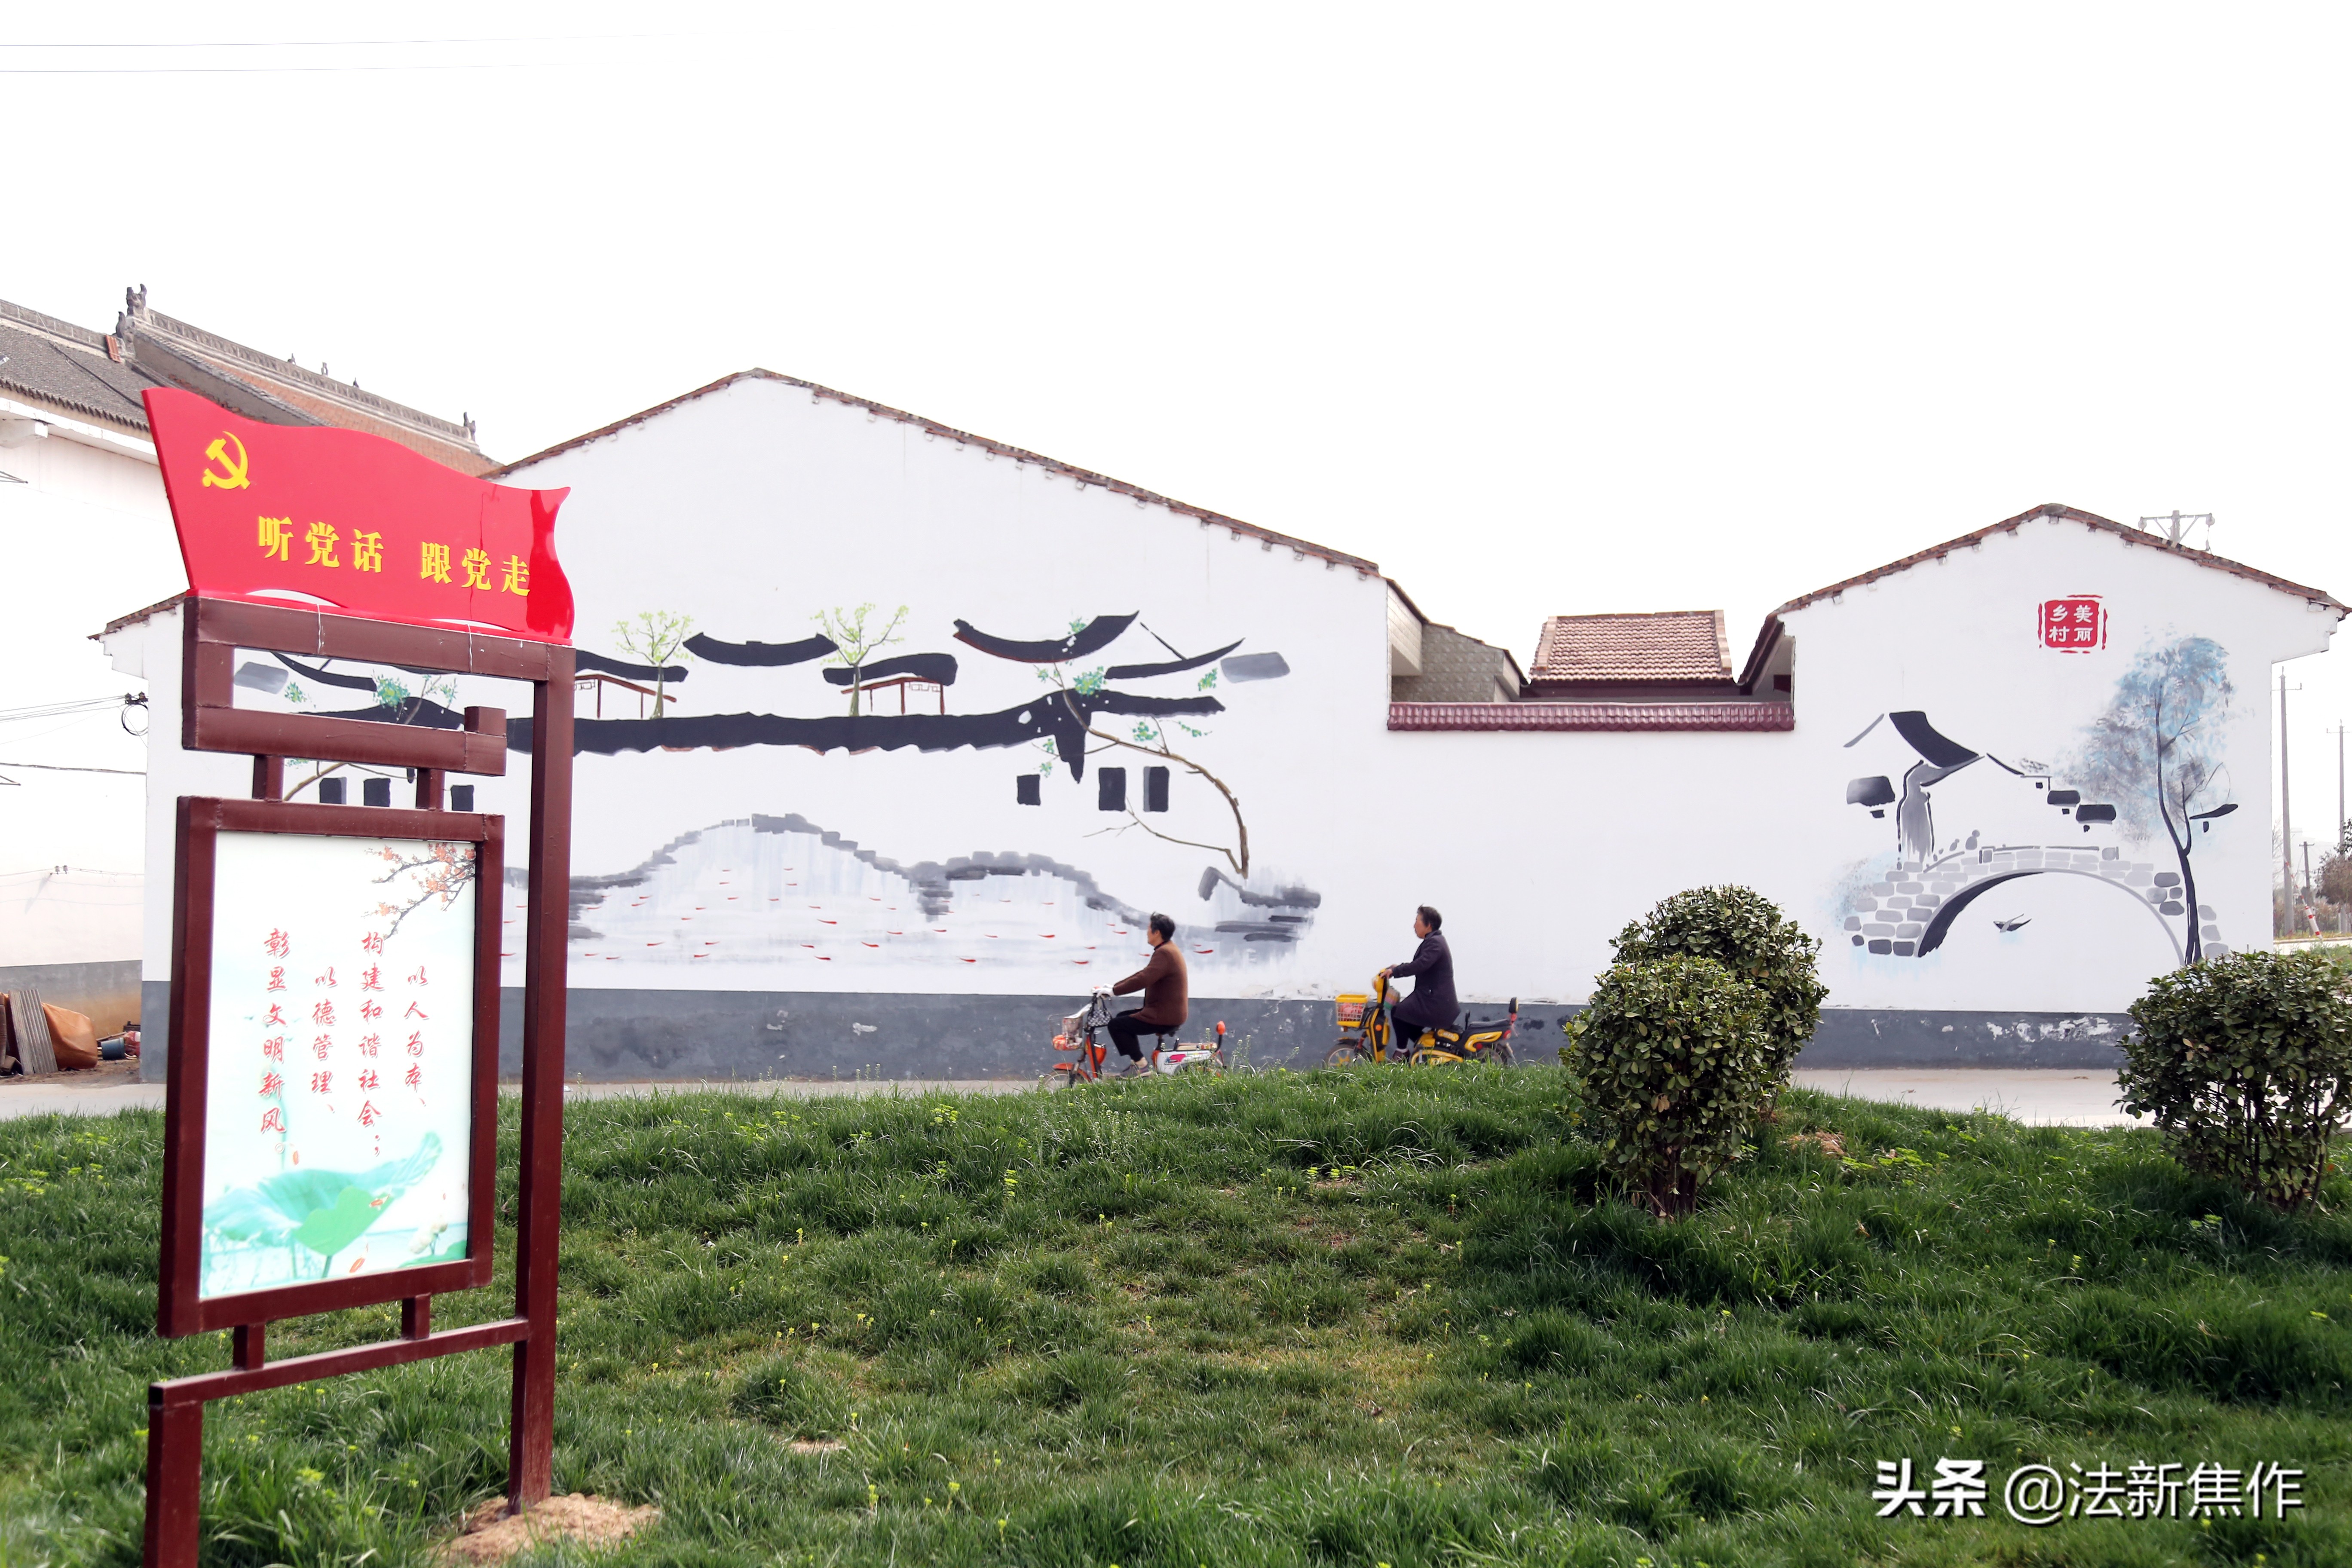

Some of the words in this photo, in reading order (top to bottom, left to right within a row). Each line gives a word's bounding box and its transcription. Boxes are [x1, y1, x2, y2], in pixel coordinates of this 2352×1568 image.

[258, 516, 384, 573] 听党话
[420, 542, 530, 597] 跟党走
[2049, 604, 2070, 643] 乡村
[2073, 604, 2094, 643] 美丽
